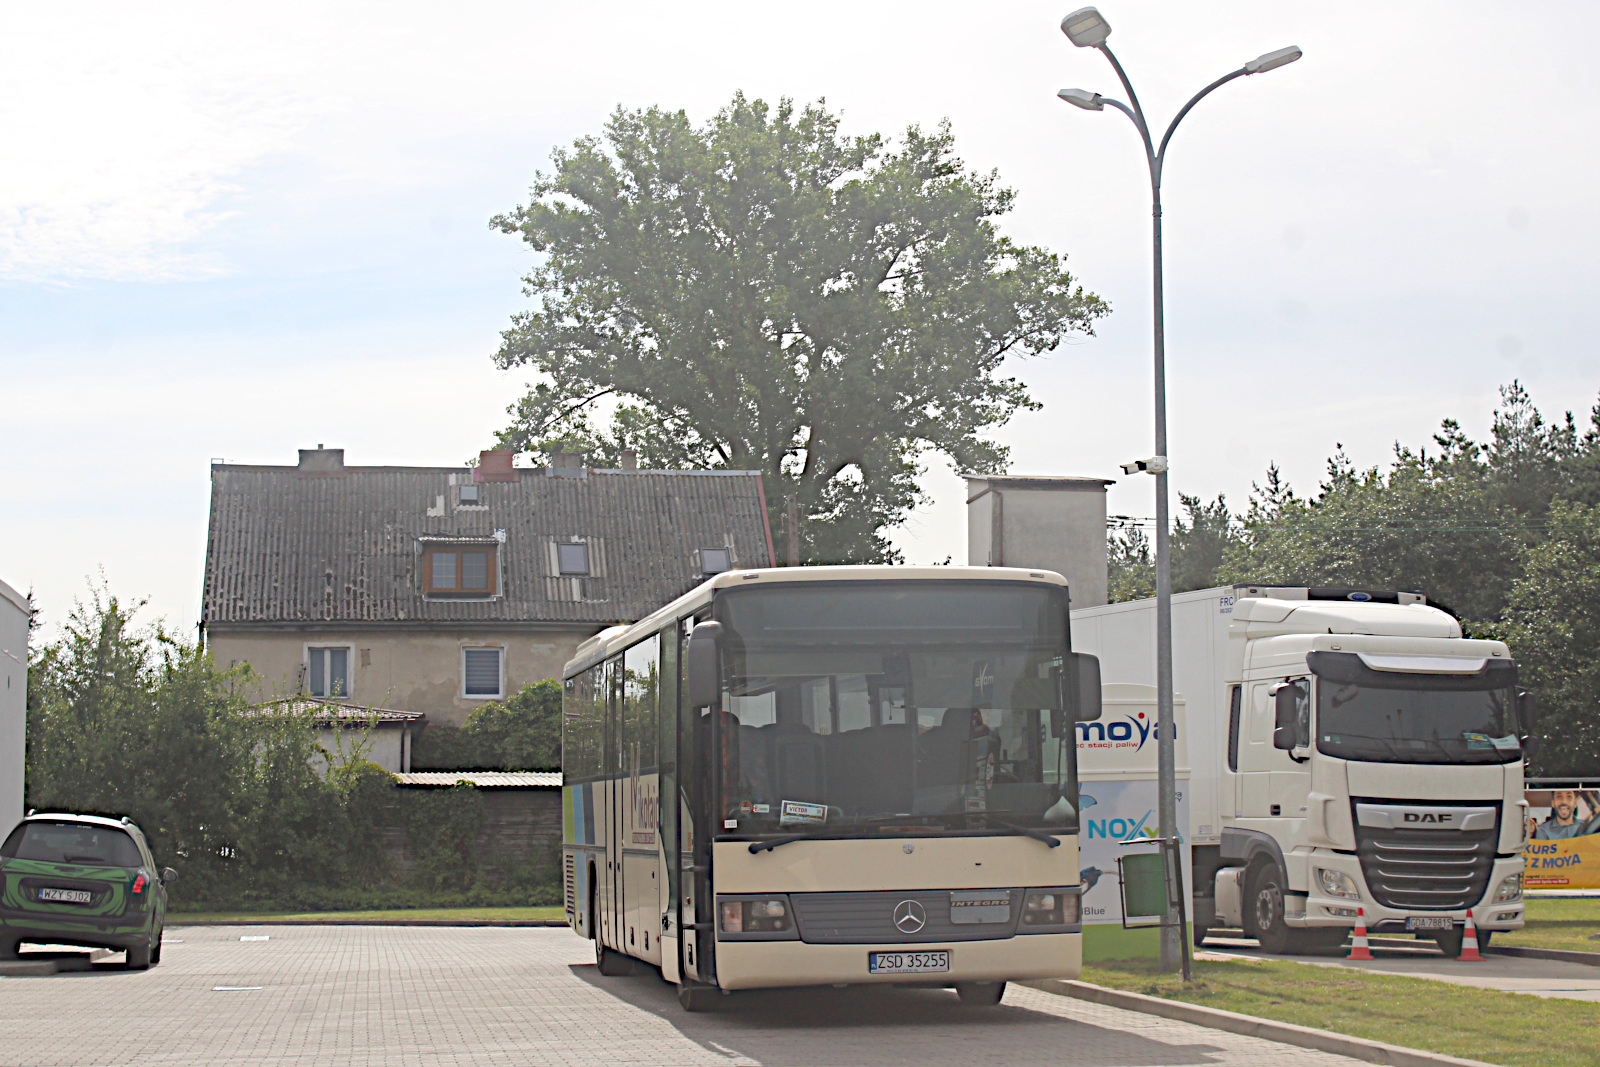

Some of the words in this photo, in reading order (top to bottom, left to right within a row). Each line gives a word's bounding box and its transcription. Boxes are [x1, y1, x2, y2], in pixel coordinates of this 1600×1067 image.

[1219, 596, 1234, 607] FRC
[1115, 741, 1139, 749] paliw
[788, 806, 808, 814] VICTOR
[1404, 813, 1452, 823] DAF
[1542, 853, 1582, 869] MOYA
[44, 889, 64, 899] WZY
[1081, 906, 1105, 915] Blue
[1410, 918, 1426, 928] GDA
[878, 955, 903, 969] ZSD
[907, 953, 946, 968] 35255
